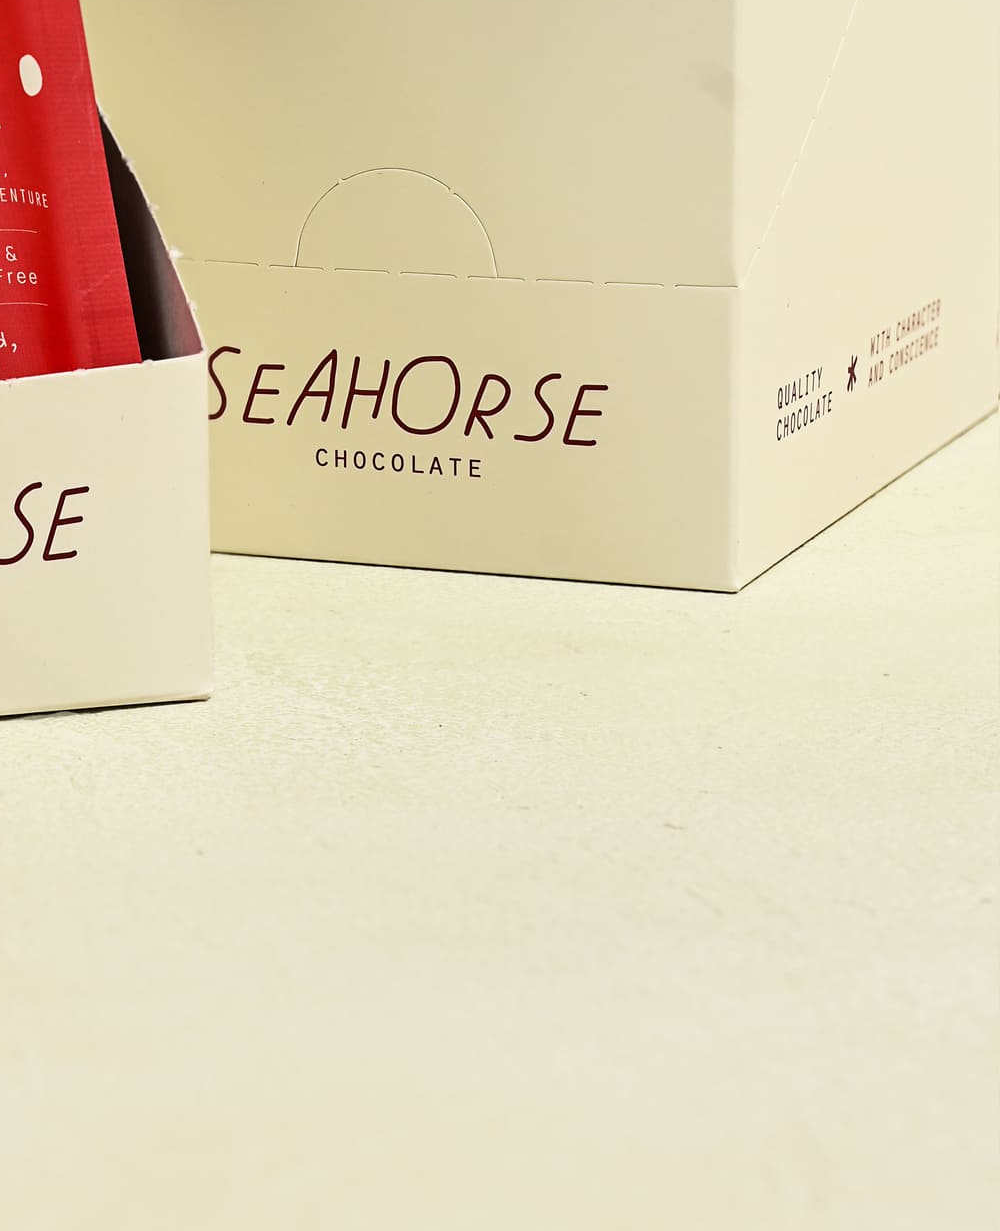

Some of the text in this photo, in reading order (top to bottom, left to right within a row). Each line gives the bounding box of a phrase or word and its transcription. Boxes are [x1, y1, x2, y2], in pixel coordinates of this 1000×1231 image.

[5, 245, 18, 262] &
[870, 298, 940, 357] WITH CHARACTER
[868, 327, 939, 388] AND CONSCIENCE
[208, 346, 609, 447] SEAHORSE
[777, 367, 823, 409] QUALITY
[776, 391, 833, 441] CHOCOLATE
[315, 448, 483, 478] CHOCOLATE
